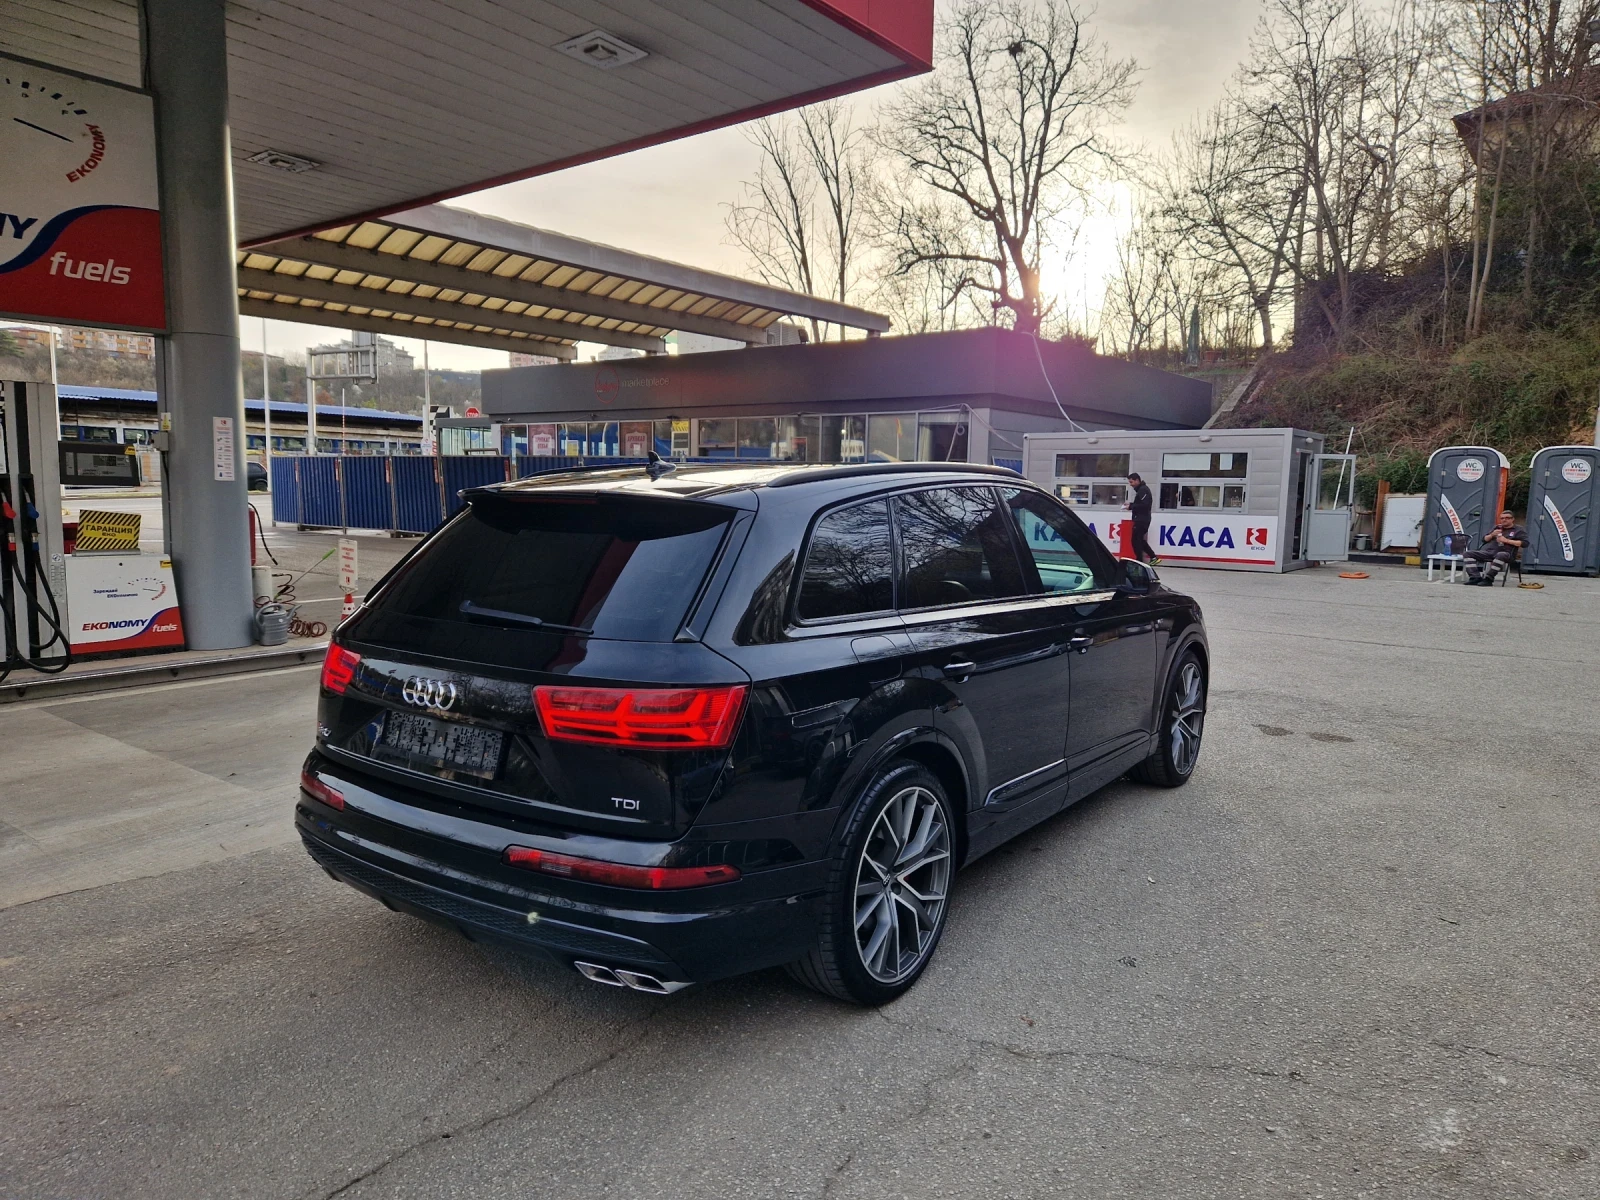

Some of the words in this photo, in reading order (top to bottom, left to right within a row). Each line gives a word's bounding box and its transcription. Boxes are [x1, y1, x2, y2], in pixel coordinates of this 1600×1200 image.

[66, 123, 106, 183] EKONOMY
[49, 251, 131, 285] fuels
[621, 377, 670, 388] marketplace
[85, 524, 133, 535] ГАРАНЦИЯ
[1159, 525, 1235, 549] КАСА
[82, 619, 149, 631] EKONOMY
[152, 623, 178, 633] fuels
[611, 797, 640, 810] TDI
